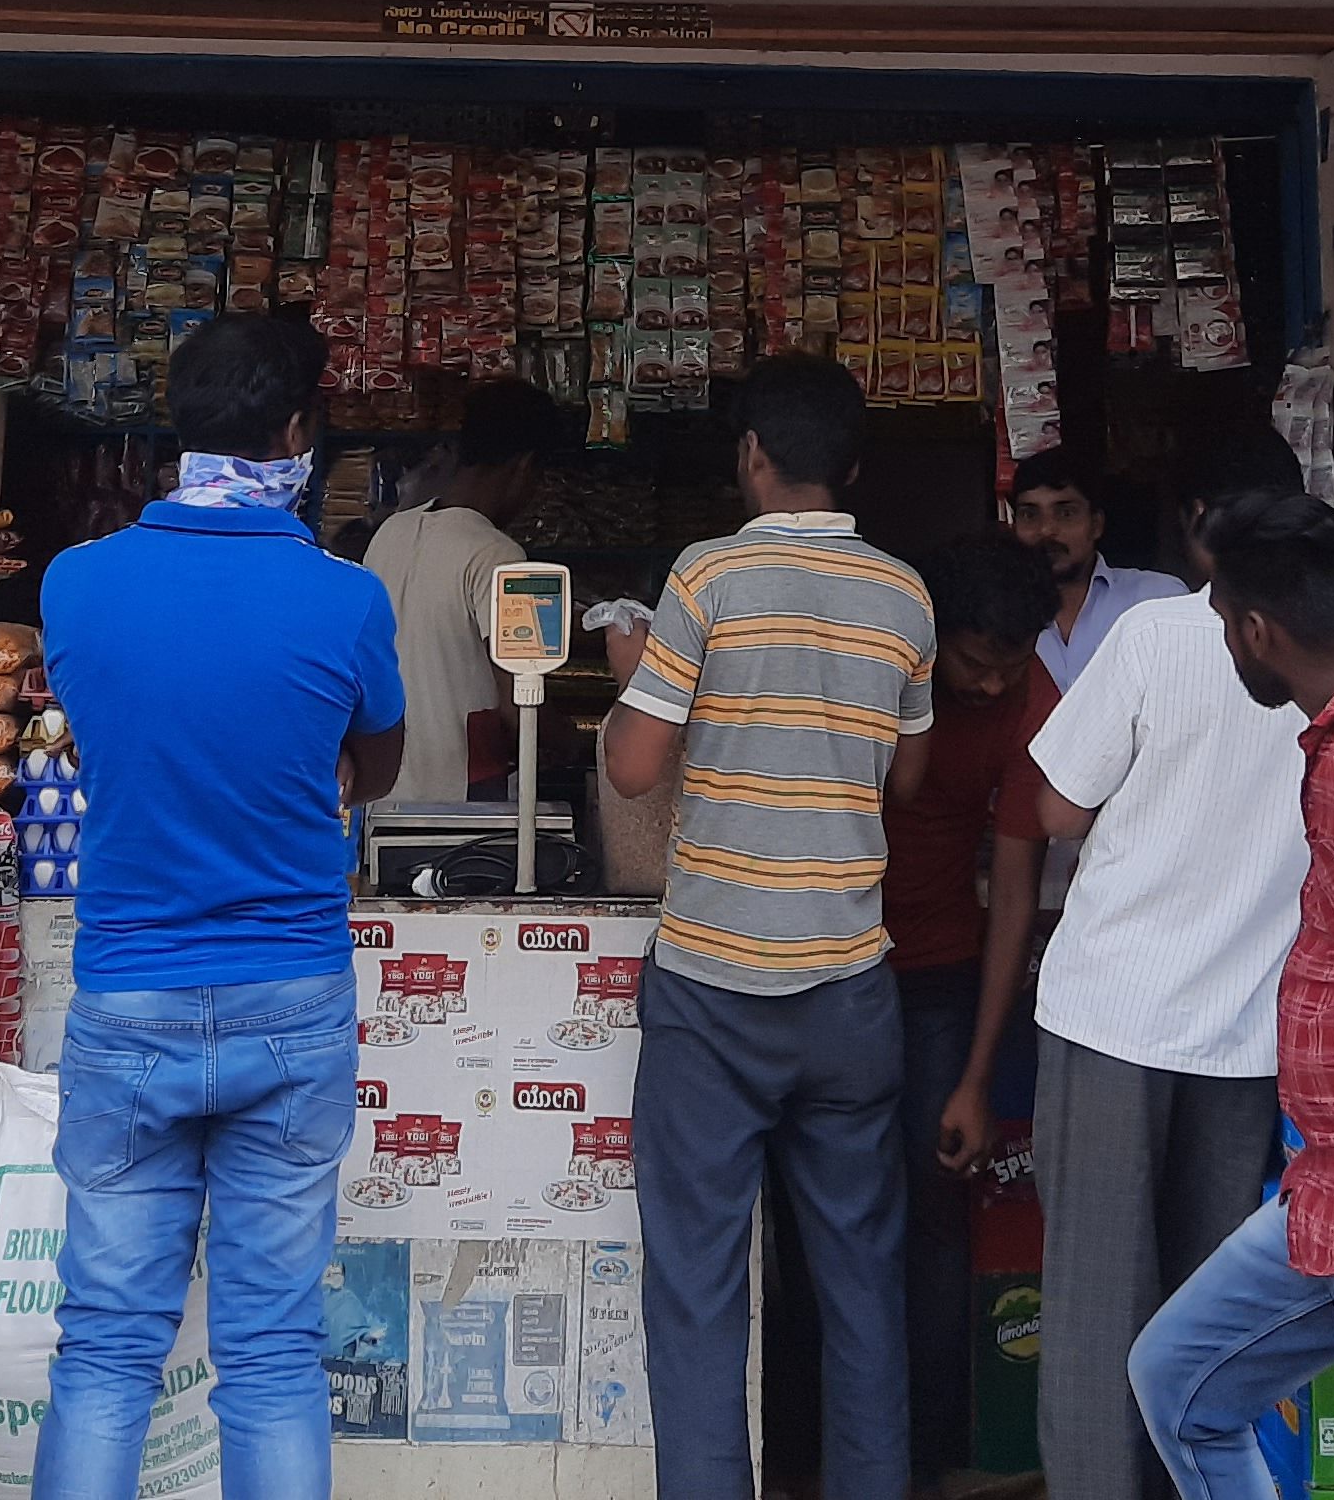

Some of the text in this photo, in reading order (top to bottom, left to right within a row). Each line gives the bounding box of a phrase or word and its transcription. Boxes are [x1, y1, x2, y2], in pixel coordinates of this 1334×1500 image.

[397, 21, 526, 36] No Credit
[596, 25, 621, 38] No
[412, 971, 435, 981] YOGI
[332, 1372, 378, 1395] OODS
